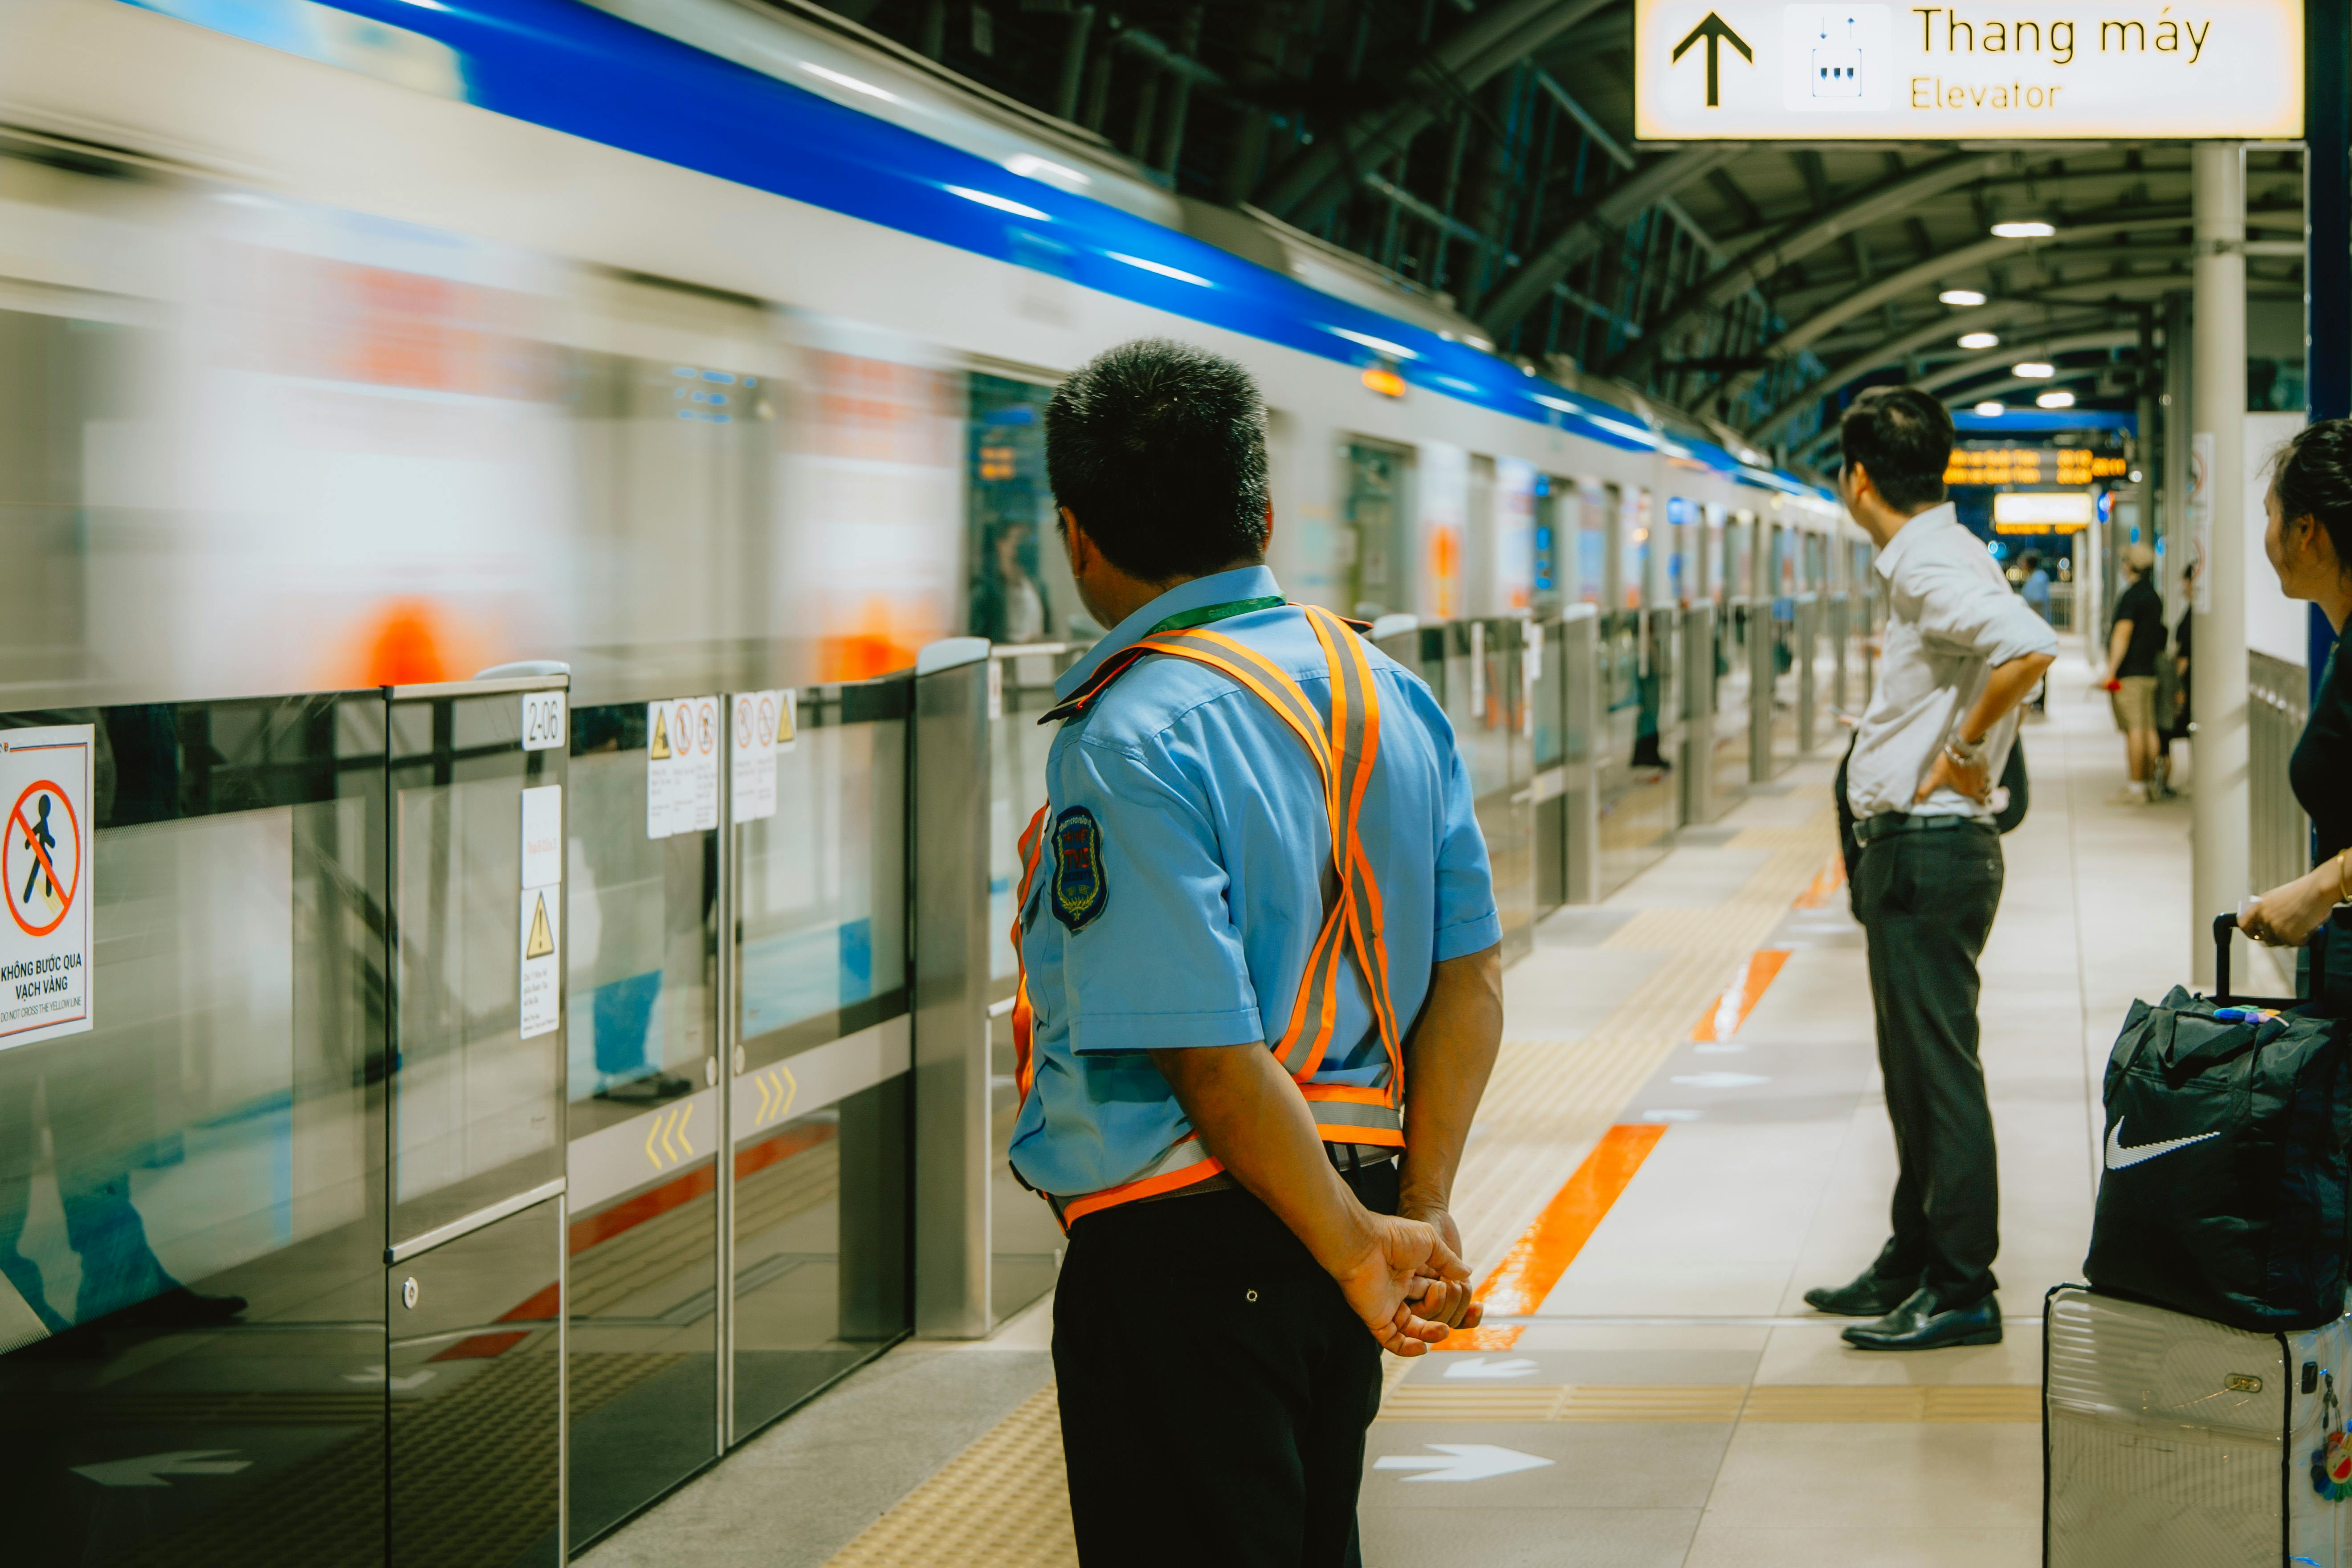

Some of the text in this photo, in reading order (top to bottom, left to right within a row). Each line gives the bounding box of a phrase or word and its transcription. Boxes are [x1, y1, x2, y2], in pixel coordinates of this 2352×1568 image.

[1912, 7, 2210, 64] Thang máy
[1912, 77, 2063, 108] Elevator
[529, 700, 558, 741] 2-06
[1063, 847, 1090, 869] TVS
[1, 953, 82, 982] KHÔNG BƯỚC QUA
[16, 975, 68, 1002] VẠCH VÀNG
[0, 996, 82, 1022] DO NOT CROSS THE YELLOW LINE
